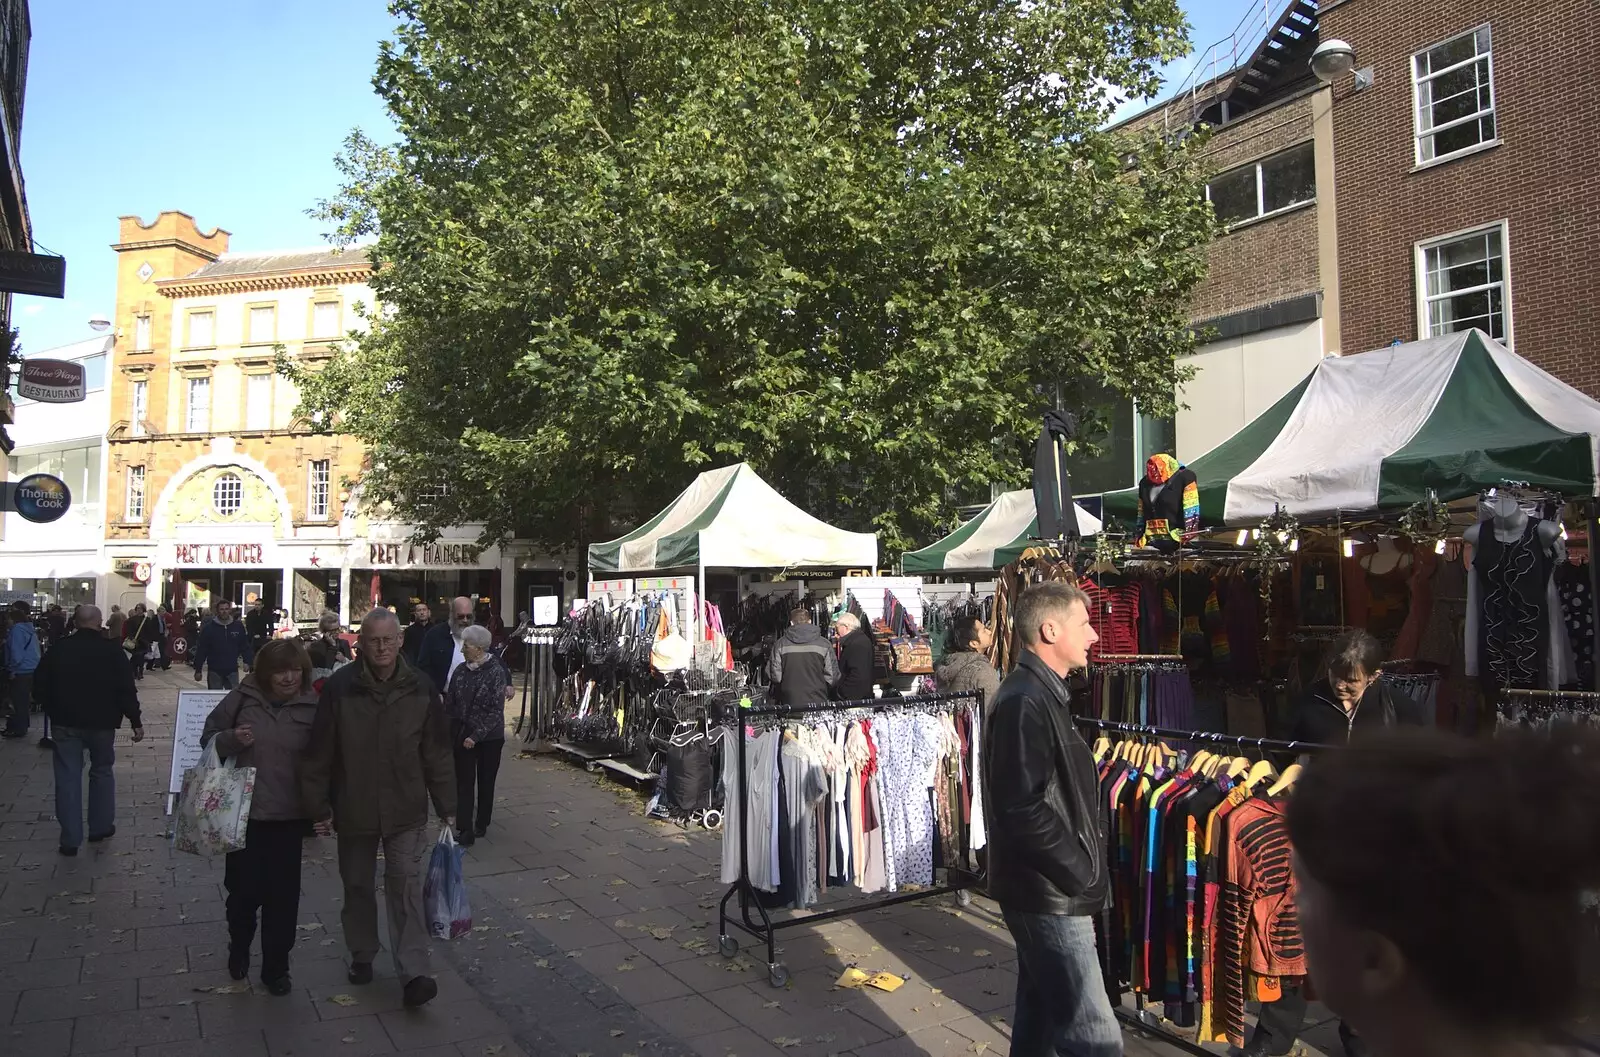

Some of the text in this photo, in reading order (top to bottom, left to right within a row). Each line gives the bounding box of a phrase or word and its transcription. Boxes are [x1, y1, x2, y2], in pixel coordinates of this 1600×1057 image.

[25, 366, 80, 383] Three Ways
[23, 385, 80, 398] RESTAURANT
[20, 489, 64, 499] Thomas
[36, 498, 63, 508] Cook
[176, 544, 263, 563] PRET A MANGER
[369, 543, 402, 564] PRET
[407, 544, 416, 564] A
